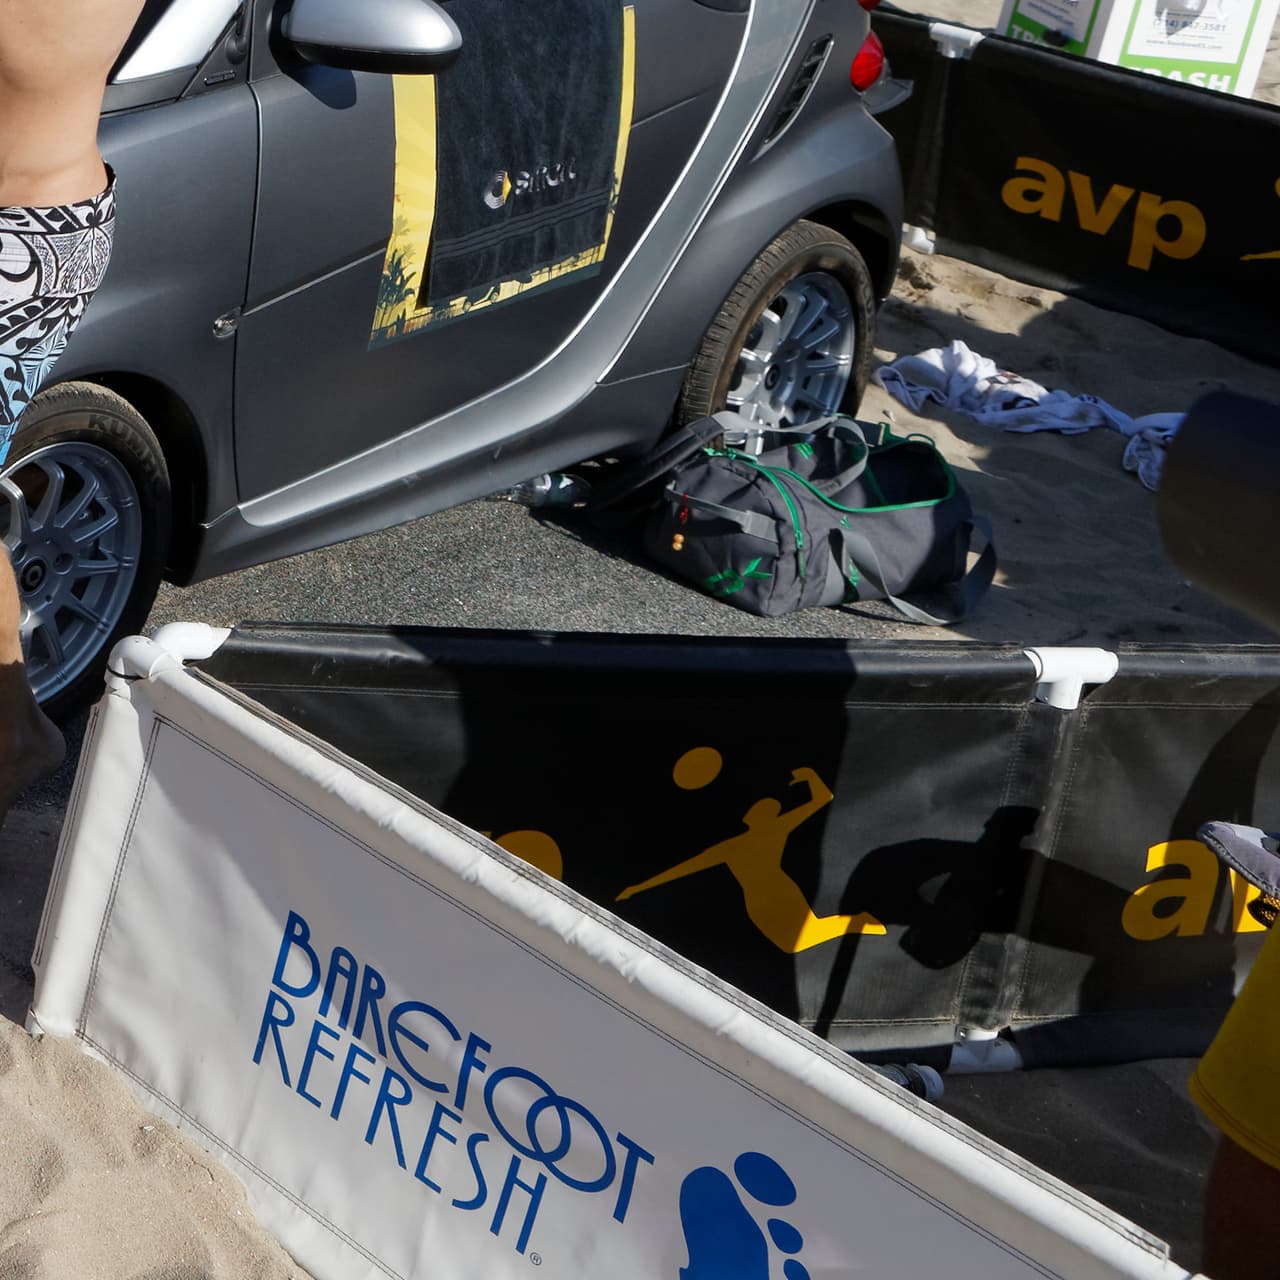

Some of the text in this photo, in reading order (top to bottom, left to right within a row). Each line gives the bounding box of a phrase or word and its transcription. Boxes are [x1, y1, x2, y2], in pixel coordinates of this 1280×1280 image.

[1001, 156, 1207, 272] avp
[252, 989, 549, 1256] REFRESH
[272, 909, 656, 1225] BAREFOOT
